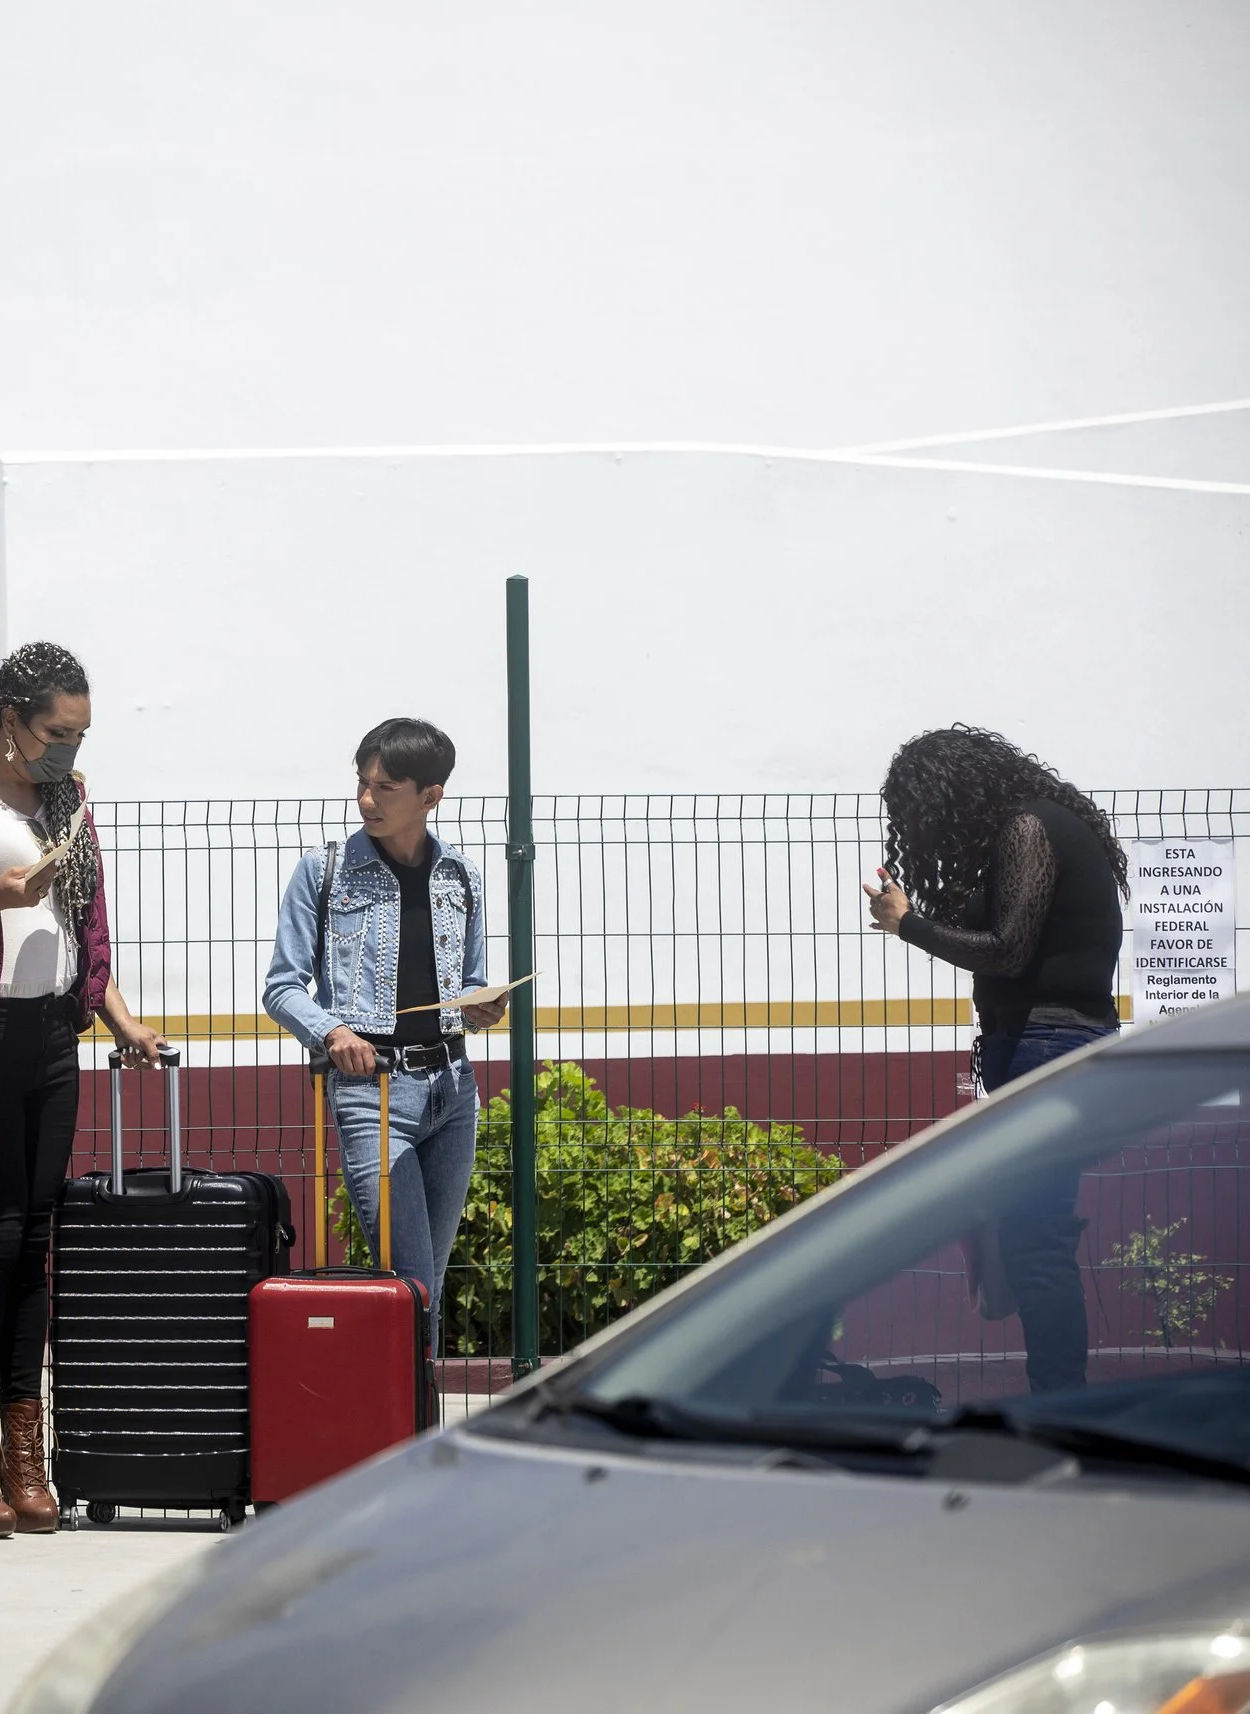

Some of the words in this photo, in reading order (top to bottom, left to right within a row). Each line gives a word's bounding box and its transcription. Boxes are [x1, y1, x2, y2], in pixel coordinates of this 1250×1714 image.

[1165, 848, 1196, 860] ESTA
[1139, 866, 1223, 878] INGRESANDO
[1160, 884, 1169, 896] A
[1173, 884, 1202, 896] UNA
[1139, 900, 1223, 914] INSTALACIÓN
[1155, 921, 1210, 932] FEDERAL
[1150, 939, 1193, 950] FAVOR
[1197, 939, 1213, 950] DE
[1136, 957, 1228, 968] IDENTIFICARSE
[1147, 975, 1217, 987] Reglamento
[1145, 990, 1189, 1000] Interior
[1191, 990, 1206, 1000] de
[1209, 989, 1220, 1000] la
